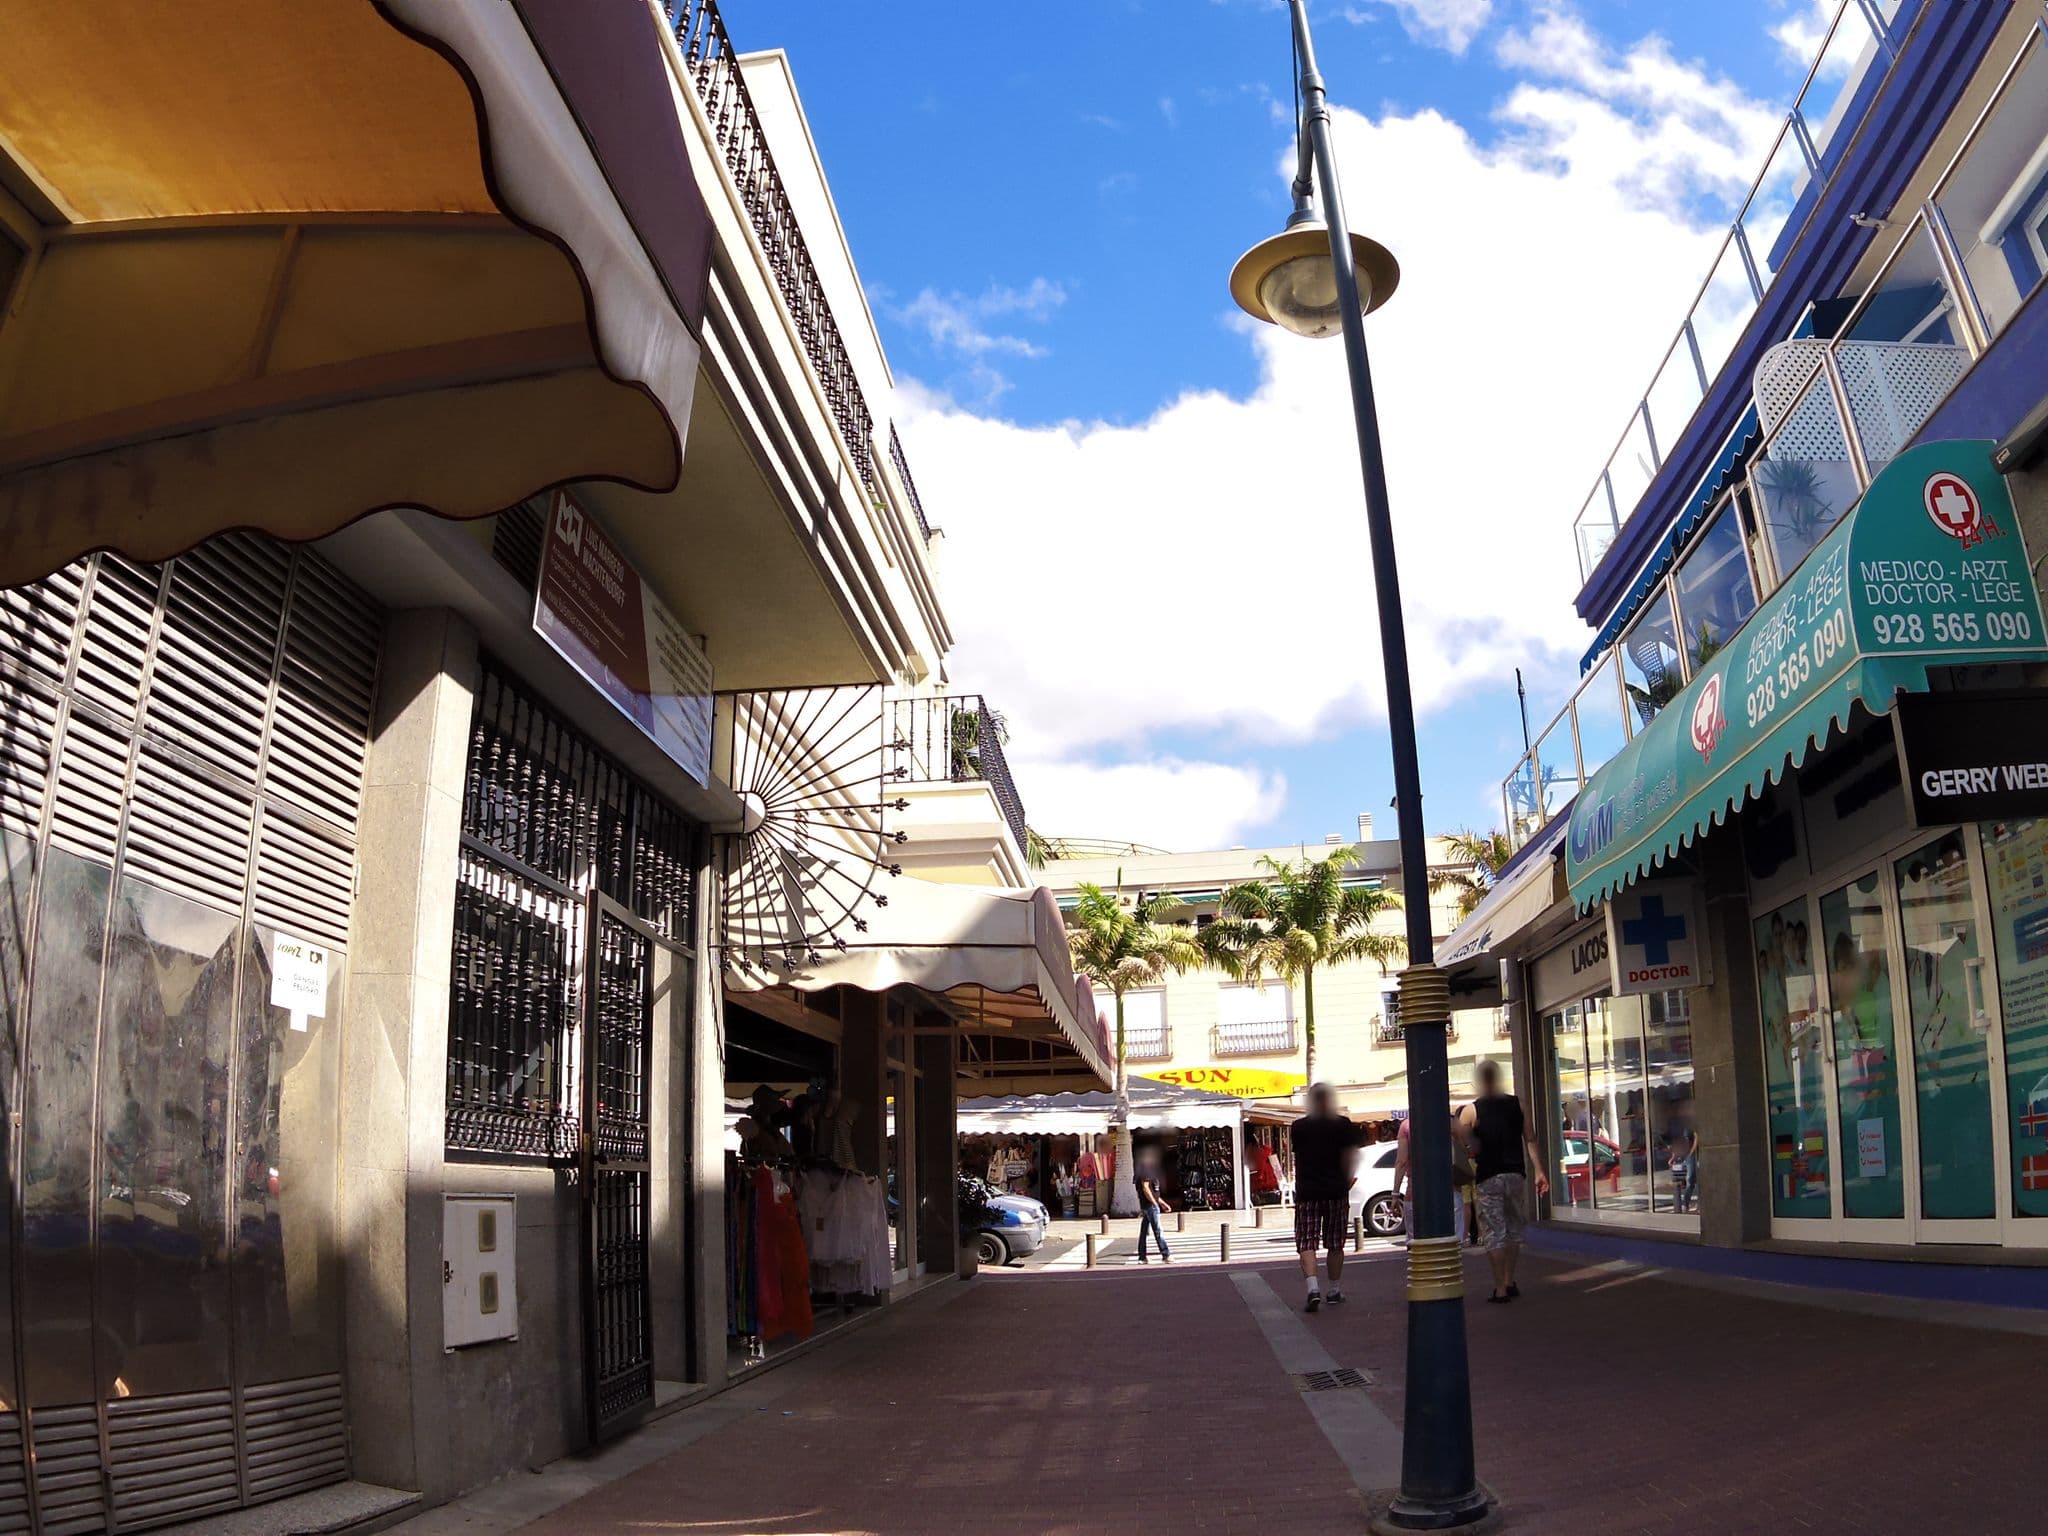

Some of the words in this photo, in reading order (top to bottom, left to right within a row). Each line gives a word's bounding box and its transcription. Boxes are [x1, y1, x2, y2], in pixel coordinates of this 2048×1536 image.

[1860, 560, 1944, 582] MEDICO
[1961, 560, 2008, 581] ARZT
[1749, 594, 1796, 658] MEDICO
[1804, 545, 1842, 602] ARZT
[1865, 583, 1956, 605] DOCTOR
[1971, 583, 2024, 603] LEGE
[1747, 615, 1796, 684] DOCTOR
[1807, 566, 1842, 625] LEGE
[1873, 614, 1925, 644] 928
[1932, 613, 1980, 642] 565
[1986, 611, 2031, 641] 090
[1747, 675, 1775, 728] 928
[1779, 642, 1810, 699] 565
[1813, 608, 1846, 668] 090
[1922, 767, 1999, 797] GERRY
[2001, 763, 2048, 791] WEB
[1571, 930, 1609, 974] LACOS
[1628, 965, 1690, 983] DOCTOR
[1159, 1070, 1232, 1085] SUN
